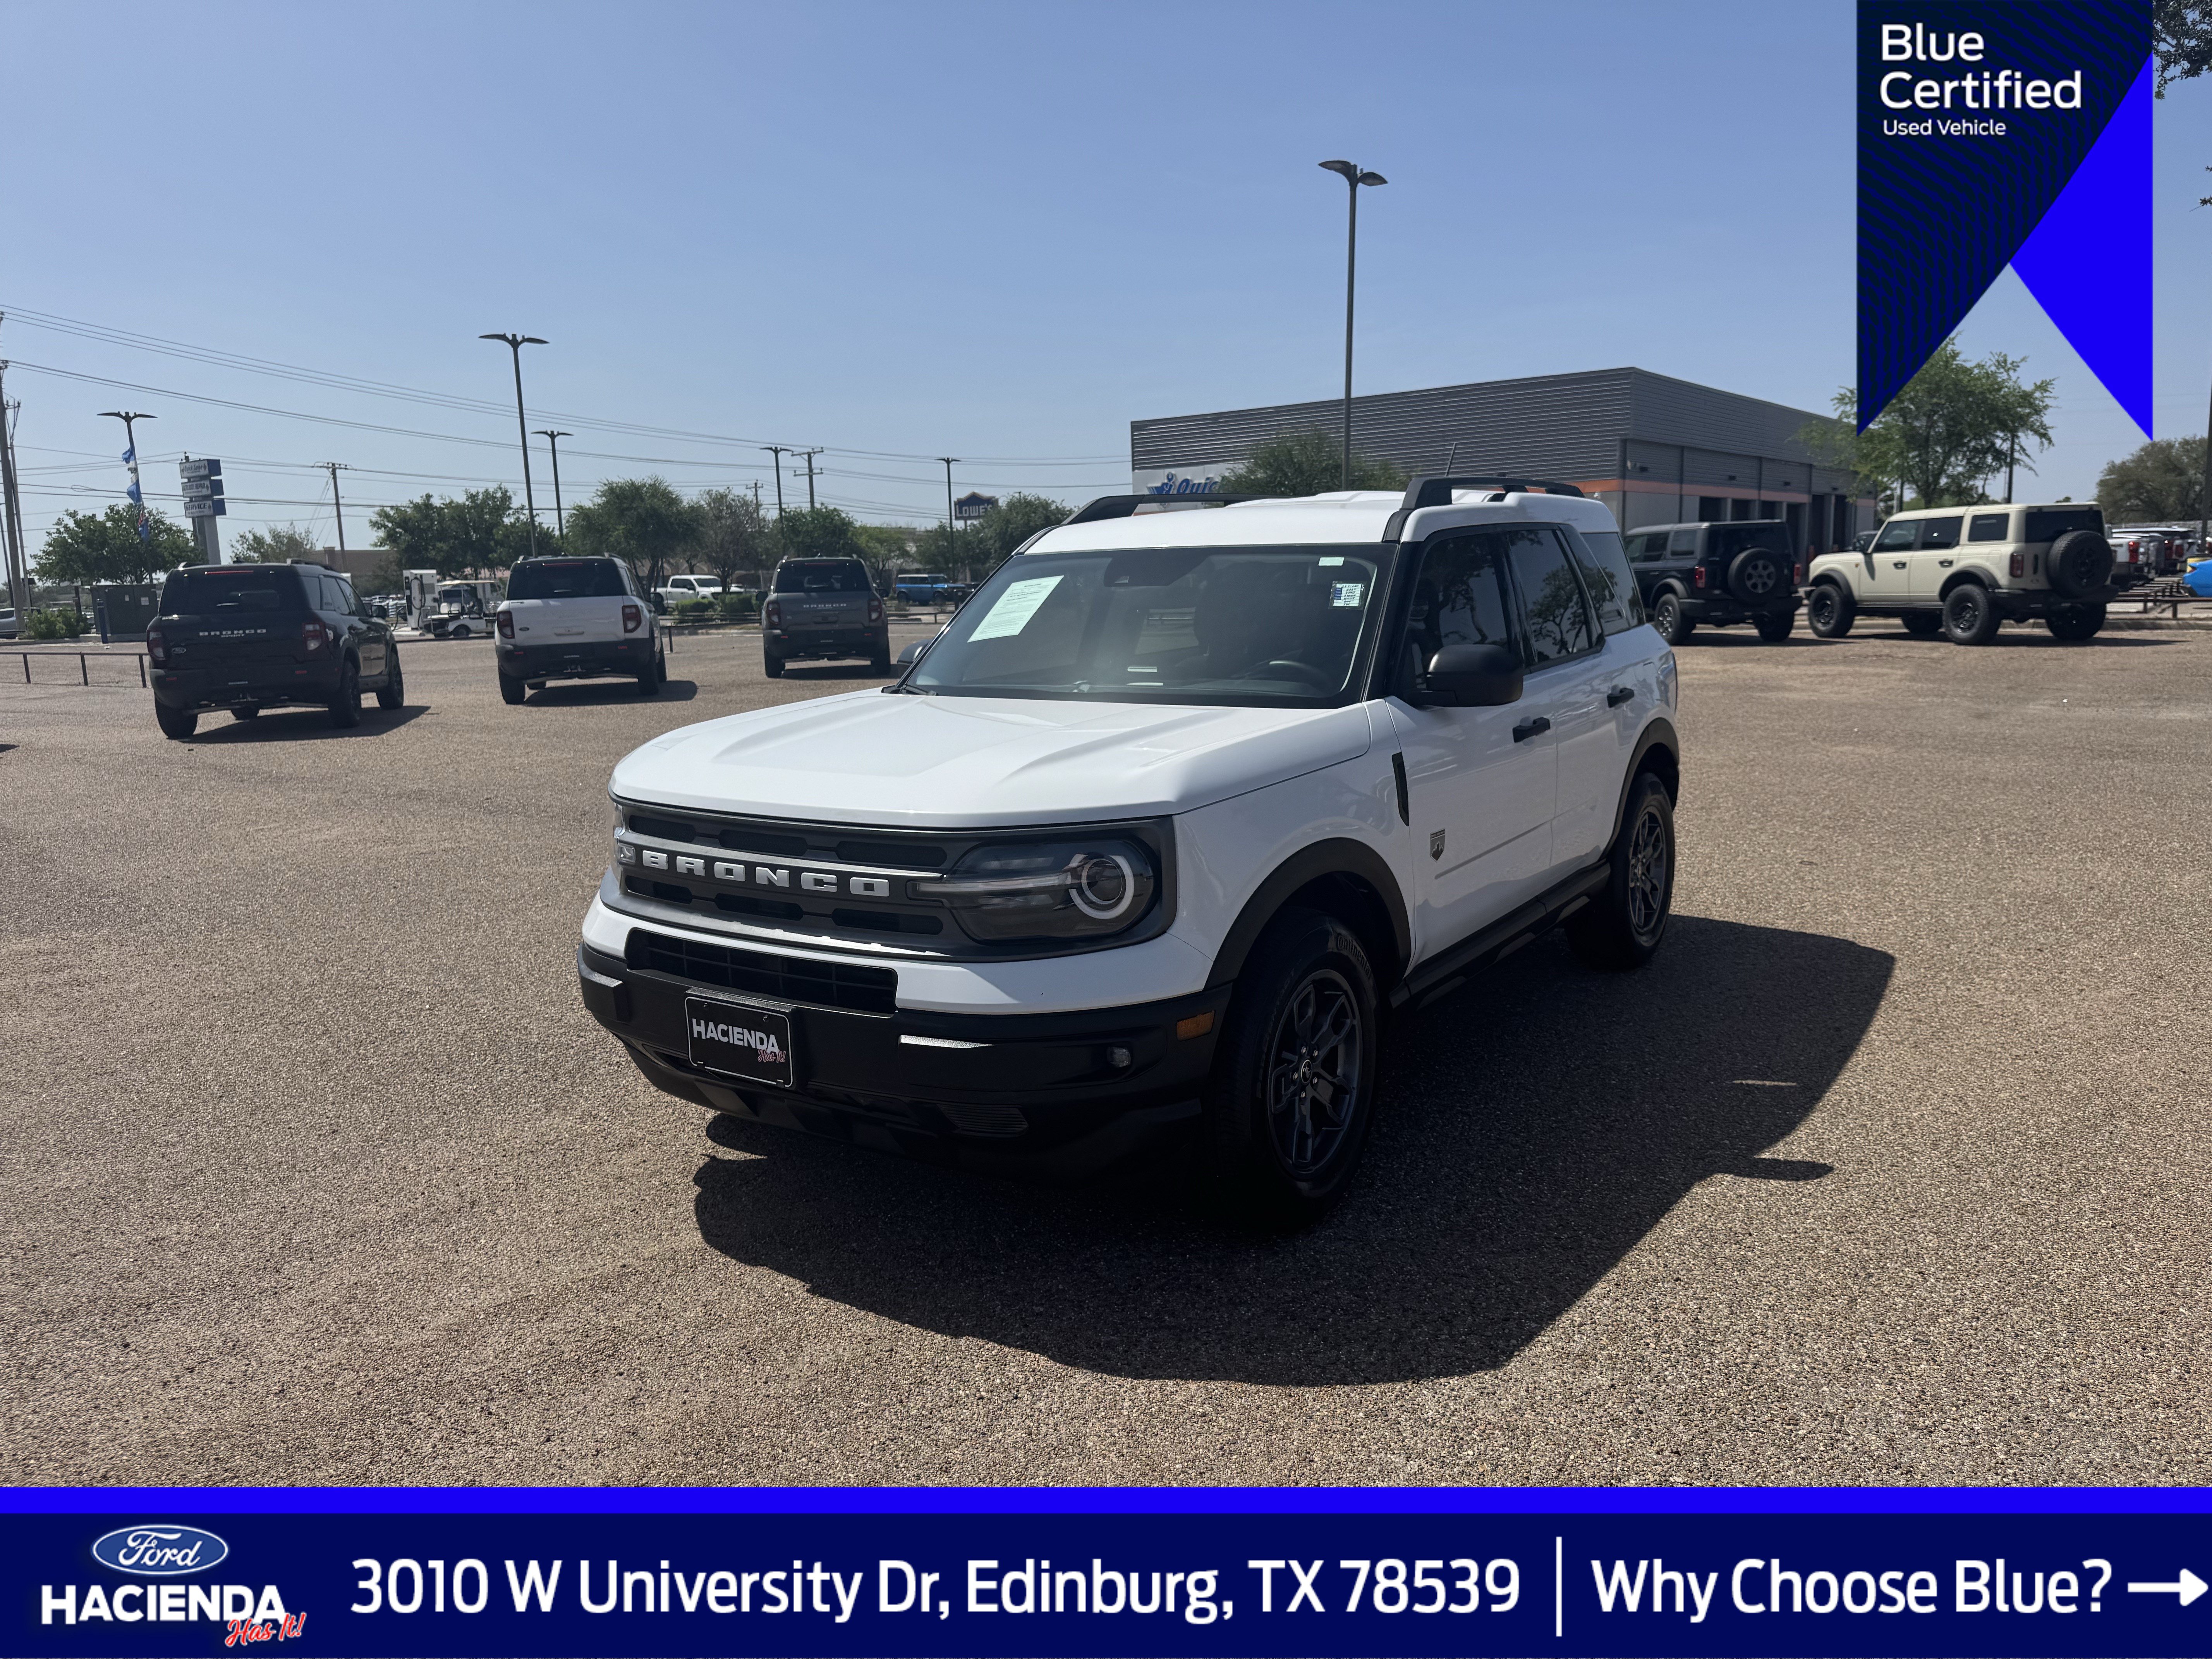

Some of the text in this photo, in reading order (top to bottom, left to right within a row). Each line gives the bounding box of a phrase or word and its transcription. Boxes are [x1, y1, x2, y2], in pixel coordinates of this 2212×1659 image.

[185, 503, 208, 511] SERVICE
[642, 850, 890, 897] BRONCO
[692, 1018, 779, 1055] HACIENDA
[757, 1049, 776, 1062] Has
